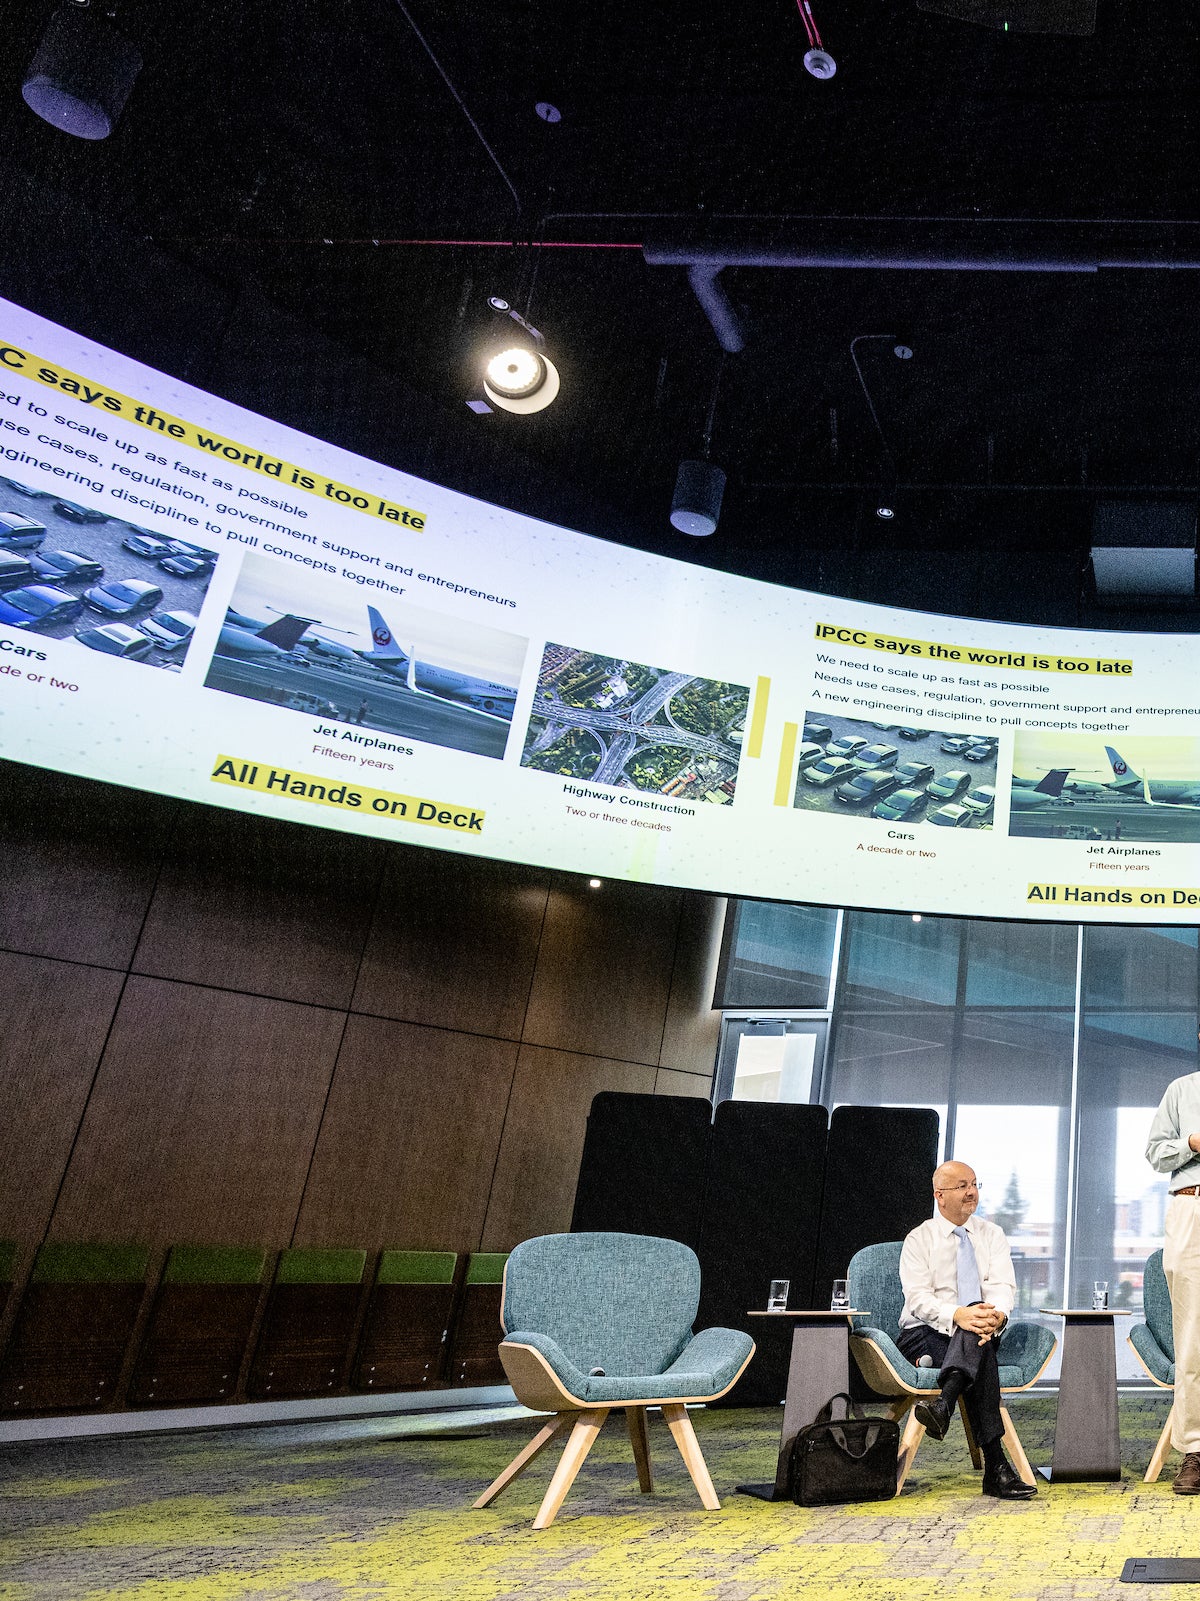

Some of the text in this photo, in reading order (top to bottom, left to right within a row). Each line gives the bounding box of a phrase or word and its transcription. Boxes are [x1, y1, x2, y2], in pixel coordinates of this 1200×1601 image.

[27, 401, 308, 519] to scale up as fast as possible
[36, 367, 123, 412] says
[134, 406, 186, 438] the
[196, 433, 284, 478] world
[290, 468, 316, 490] is
[324, 483, 370, 509] too
[377, 501, 425, 530] late
[0, 418, 517, 608] se cases, regulation, government support and entrepreneurs
[110, 488, 200, 526] discipline
[205, 521, 222, 534] to
[226, 530, 259, 547] pull
[262, 543, 337, 574] concepts
[341, 568, 407, 595] together
[0, 639, 48, 661] Cars
[815, 624, 1133, 674] IPCC says the world is too late
[26, 673, 80, 693] or two
[816, 653, 1050, 694] We need to scale up as fast as possible
[814, 671, 853, 686] Needs
[856, 680, 878, 690] use
[881, 685, 920, 698] cases,
[923, 691, 986, 706] regulation,
[989, 699, 1060, 711] government
[1063, 704, 1107, 715] support
[1110, 706, 1132, 714] and
[811, 689, 1128, 732] A new engineering discipline to pull concepts together
[312, 724, 414, 756] Jet Airplanes
[312, 744, 395, 771] Fifteen years
[211, 759, 485, 831] All Hands on Deck
[563, 783, 696, 817] Highway Construction
[565, 805, 672, 832] Two or three decades
[856, 843, 937, 859] A decade or two
[887, 830, 915, 841] Cars
[1086, 845, 1161, 857] Jet Airplanes
[1089, 861, 1150, 873] Fifteen years
[1027, 885, 1057, 901] All
[1064, 887, 1133, 904] Hands
[1139, 893, 1166, 904] on
